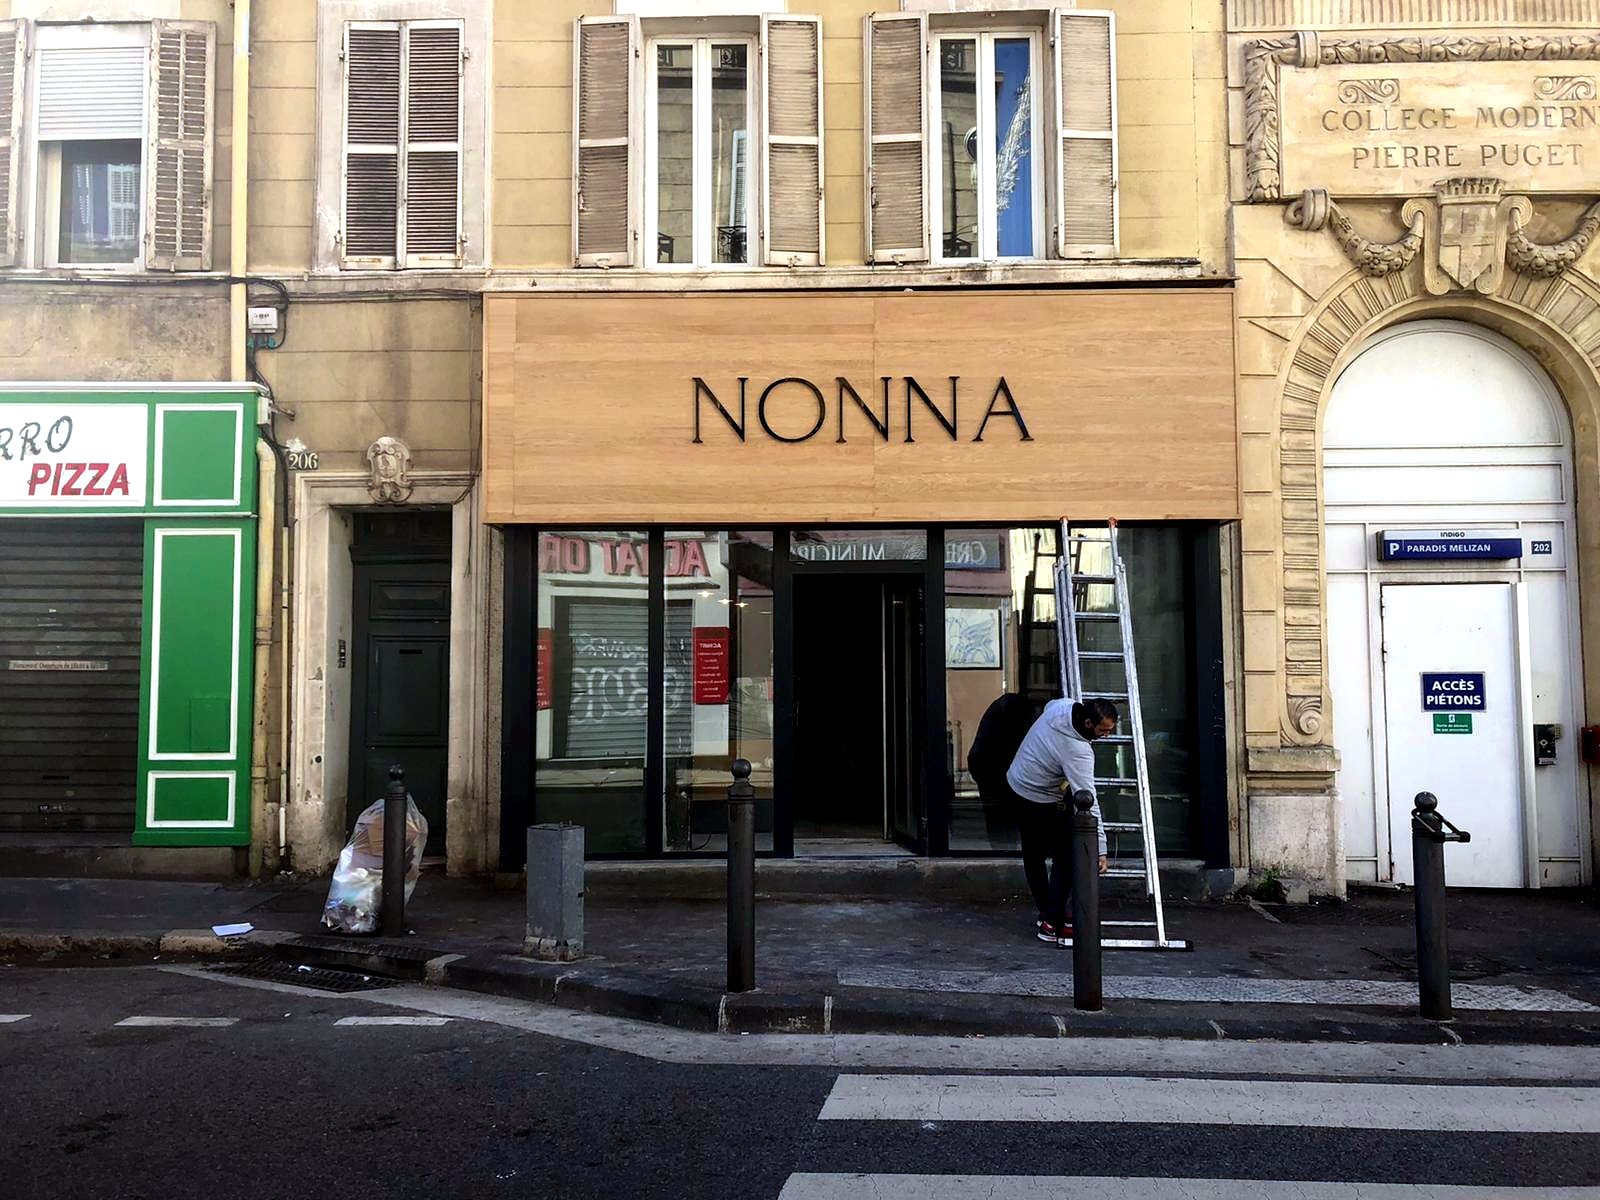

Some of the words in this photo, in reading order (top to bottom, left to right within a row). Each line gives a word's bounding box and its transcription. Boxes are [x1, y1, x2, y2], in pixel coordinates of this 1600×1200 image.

[1322, 108, 1457, 131] COLLEGE
[1476, 105, 1600, 128] MODERN
[1353, 145, 1462, 168] PIERRE
[1480, 144, 1582, 166] PUGET
[692, 376, 1035, 443] NONNA
[289, 453, 318, 469] 206
[28, 463, 129, 496] PIZZA
[1390, 543, 1400, 555] P
[1407, 544, 1447, 553] PARADIS
[1450, 544, 1491, 552] MELIZAN
[1534, 544, 1550, 552] 202
[1432, 679, 1475, 691] ACCÈS
[1427, 693, 1482, 705] PIÉTONS
